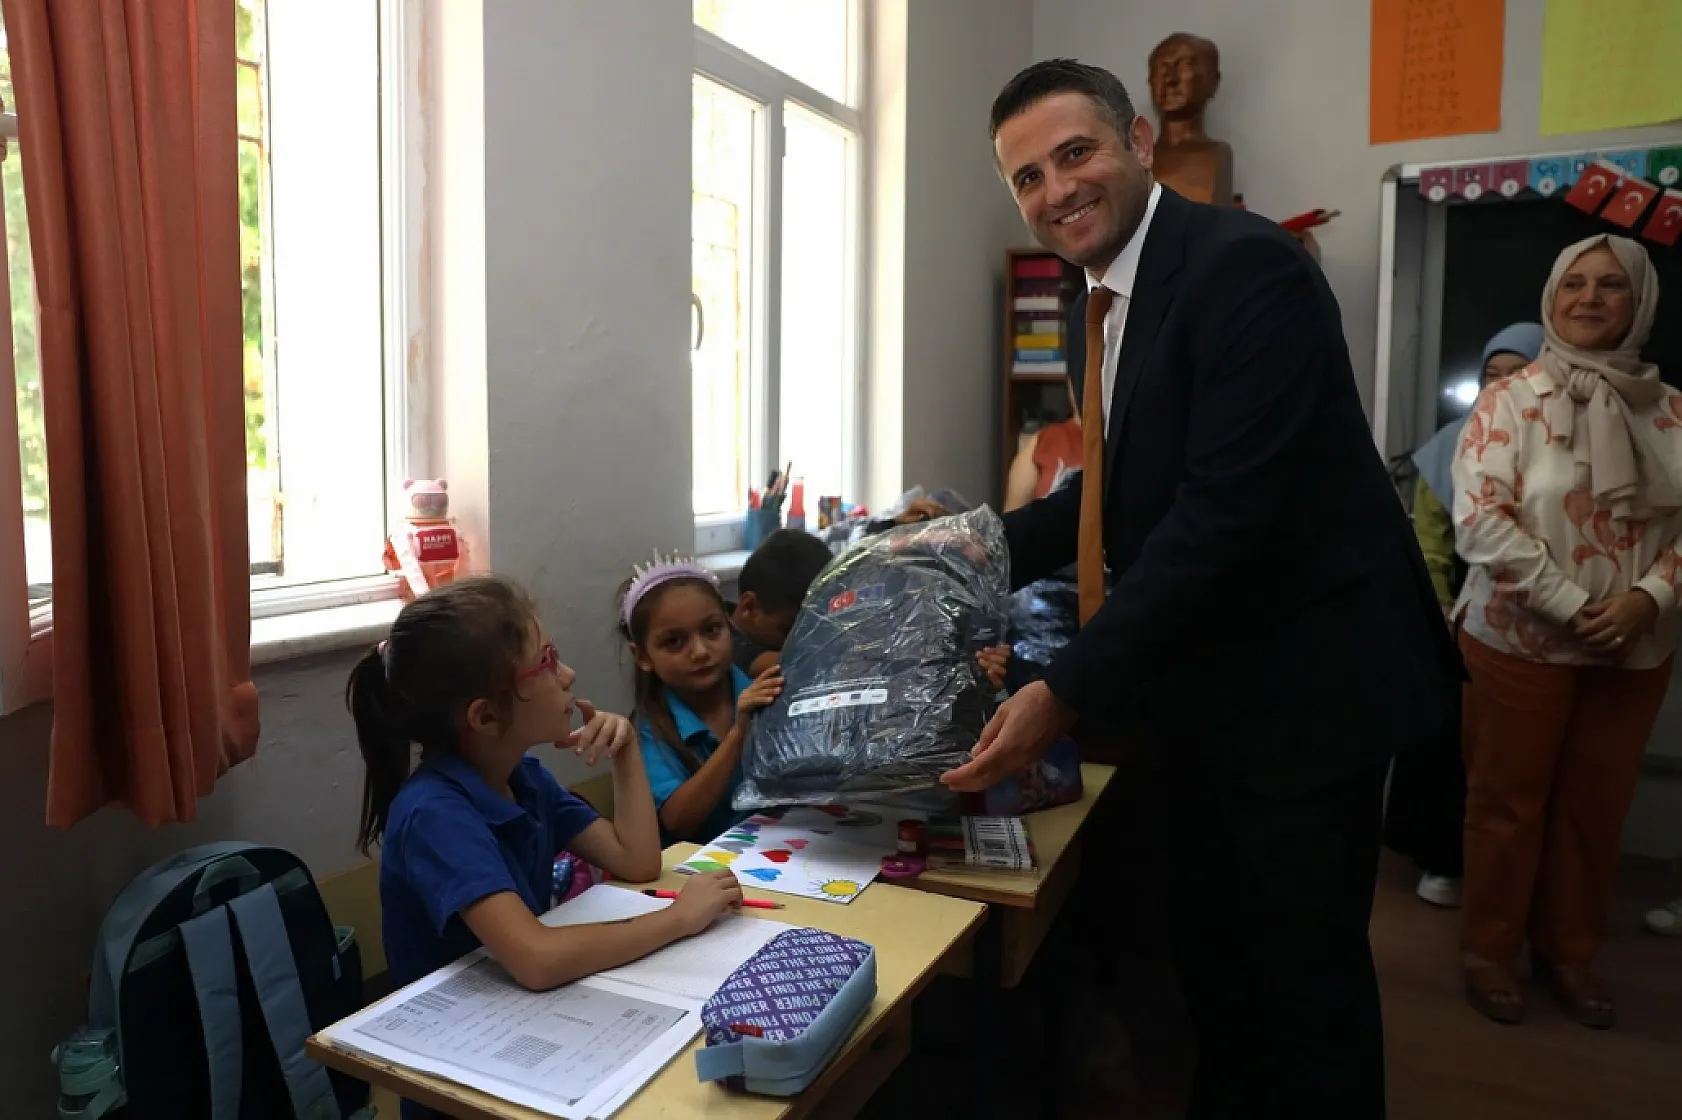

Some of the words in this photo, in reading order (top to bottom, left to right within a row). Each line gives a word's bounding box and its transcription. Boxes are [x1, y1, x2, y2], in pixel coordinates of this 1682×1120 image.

[749, 961, 780, 974] FIND
[780, 957, 807, 968] THE
[807, 952, 852, 966] POWER
[757, 970, 804, 985] POWER
[804, 967, 832, 979] THE
[730, 989, 763, 1002] FIND
[763, 982, 796, 997] FIND
[797, 979, 824, 991] THE
[773, 993, 821, 1010] POWER
[720, 1000, 771, 1020] POWER
[780, 1011, 812, 1025] FIND
